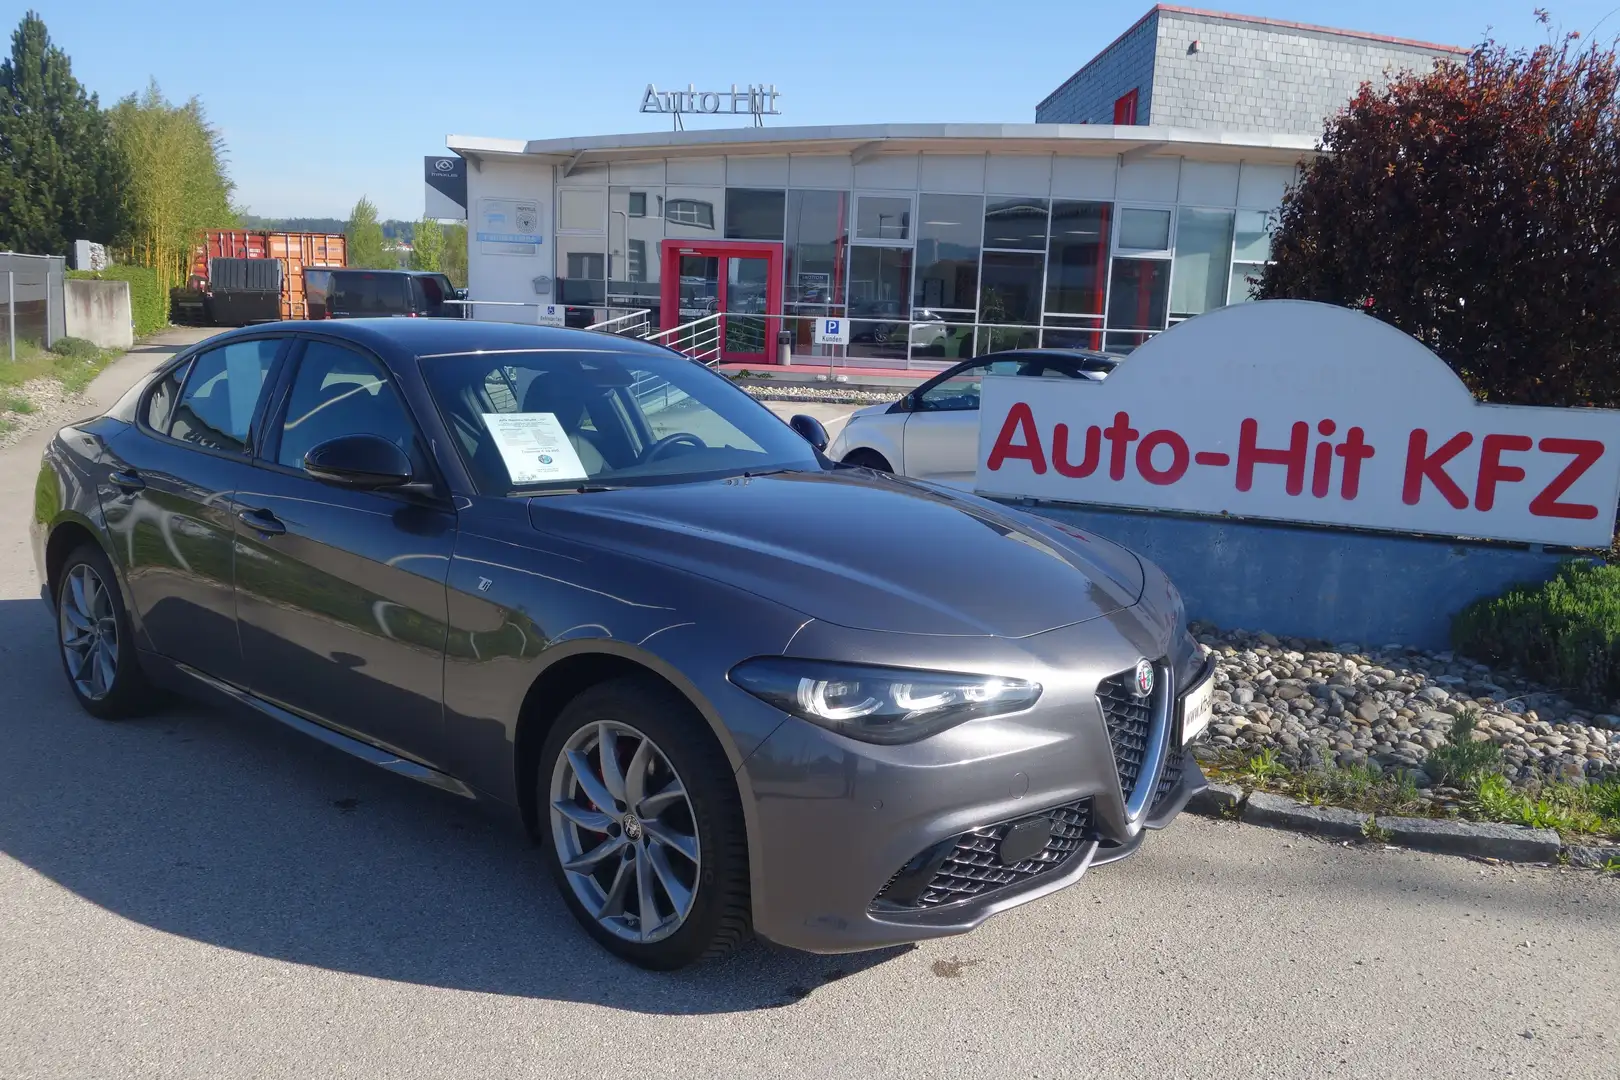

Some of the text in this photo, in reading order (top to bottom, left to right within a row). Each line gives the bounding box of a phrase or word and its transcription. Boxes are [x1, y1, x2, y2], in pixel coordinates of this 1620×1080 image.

[639, 83, 782, 115] Auto Hit
[987, 402, 1606, 521] Auto-Hit KFZ
